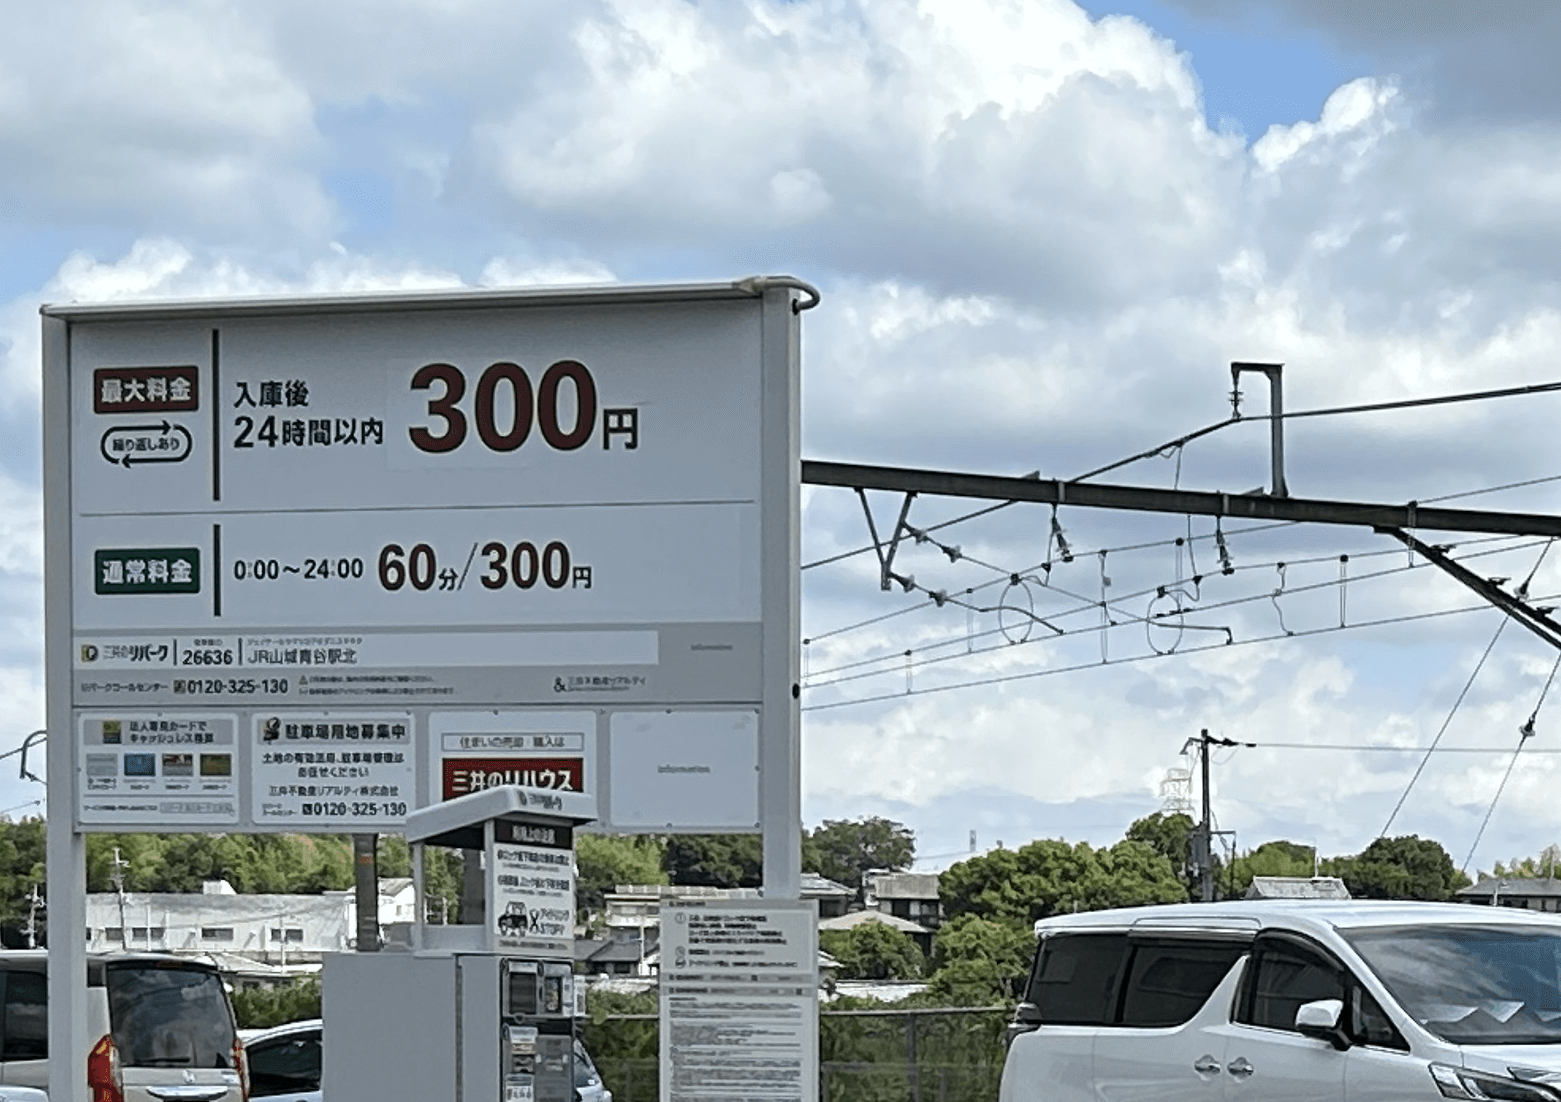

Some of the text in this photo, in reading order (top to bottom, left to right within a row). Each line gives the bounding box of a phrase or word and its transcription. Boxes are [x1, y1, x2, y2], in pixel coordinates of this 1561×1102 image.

[101, 377, 192, 402] 最大料金
[233, 380, 309, 408] 入庫後
[408, 360, 639, 453] 300円
[233, 415, 384, 449] 24時間以内
[112, 437, 181, 452] 繰り返しあり
[102, 559, 193, 584] 通常料金
[378, 541, 592, 591] 60分/300円
[182, 649, 233, 665] 26636
[247, 649, 357, 664] JR山城青谷駅北
[187, 679, 288, 693] 0120-325-130
[285, 724, 405, 740] 駐車場用地募集中
[298, 766, 369, 778] お任せください
[452, 769, 573, 792] 三井のリハウス
[269, 785, 398, 797] 三井不動産リアルティ株式会社
[313, 802, 407, 817] 0120-325-130
